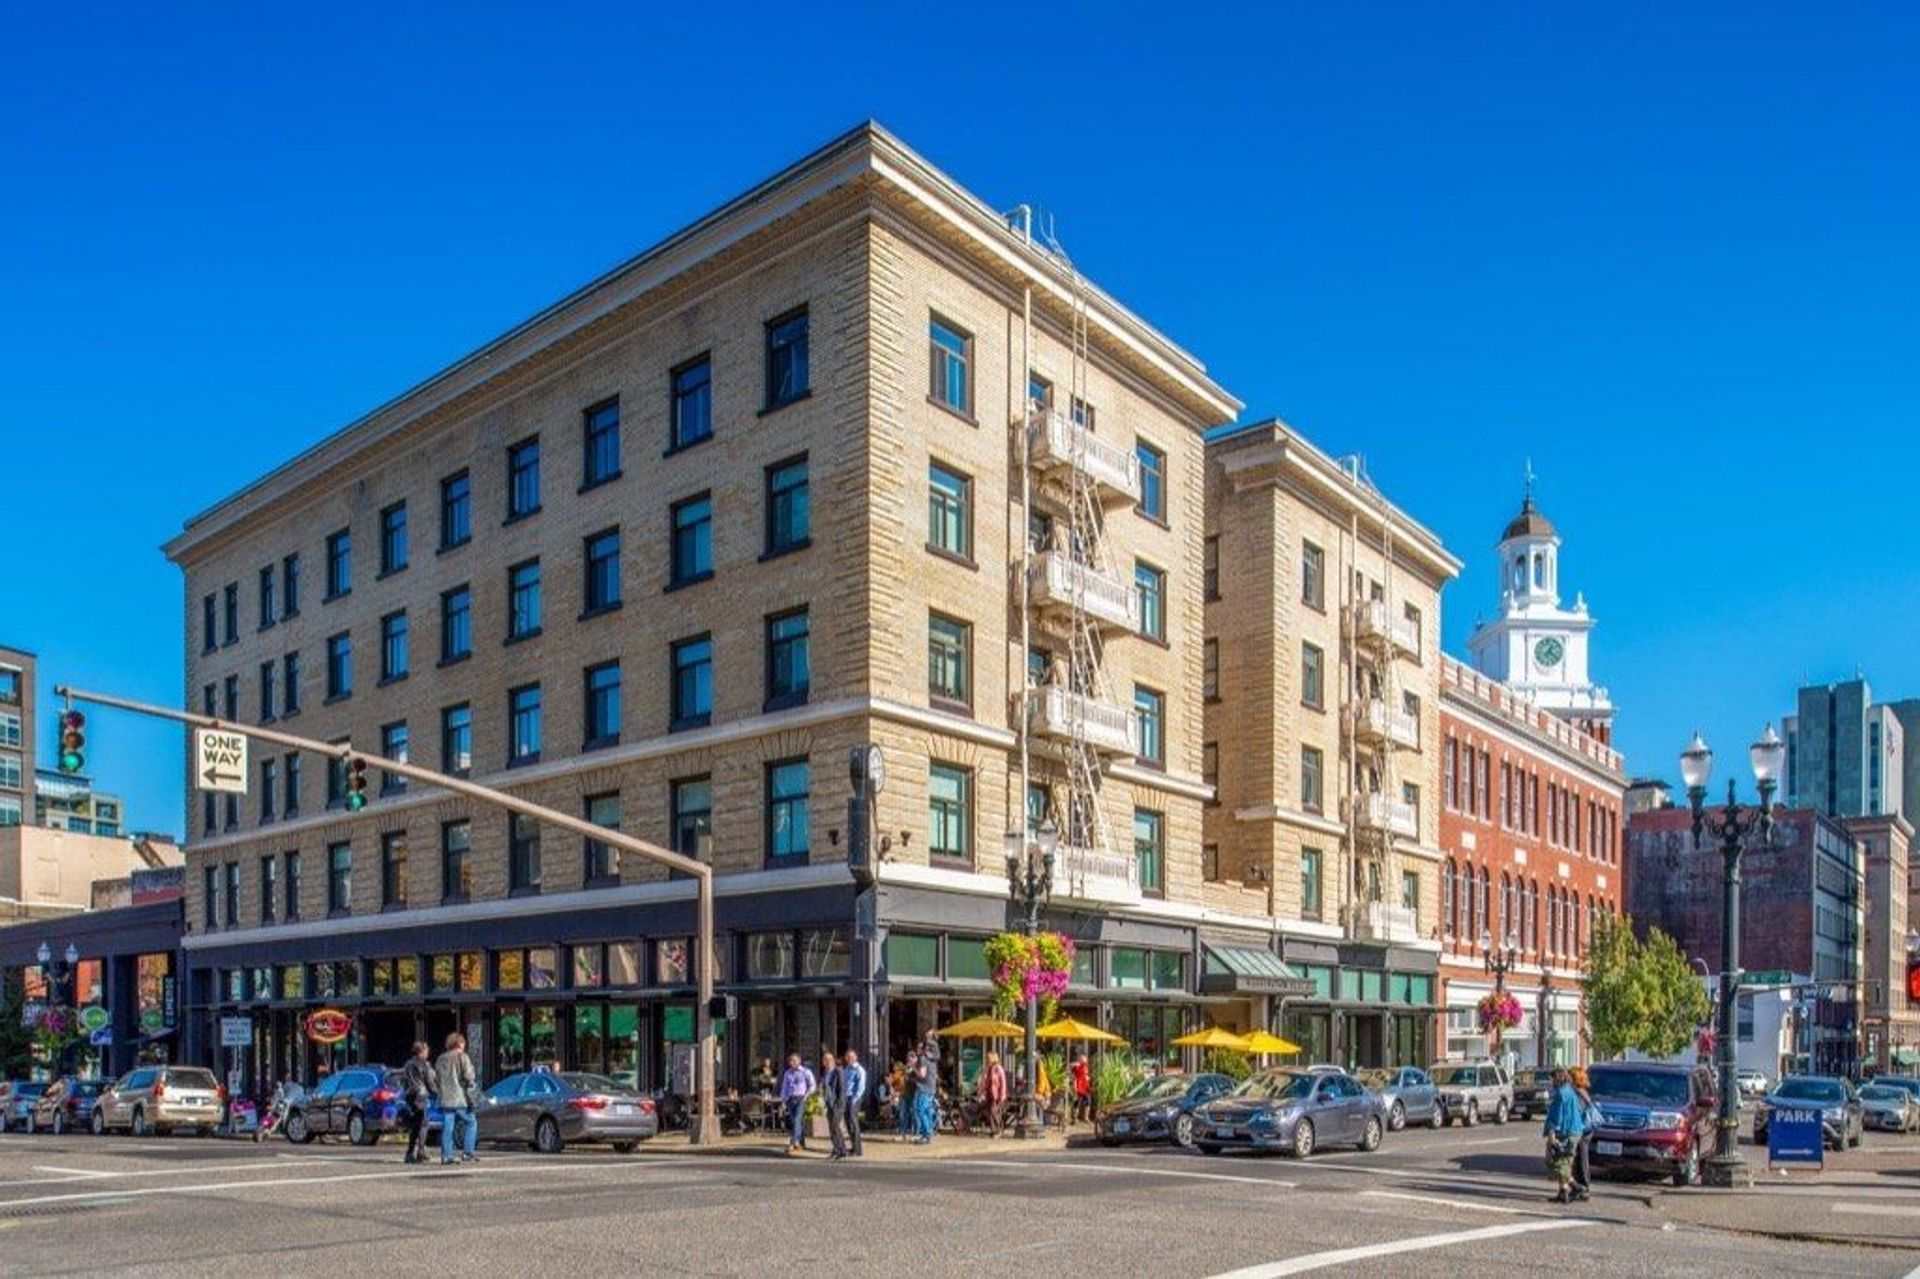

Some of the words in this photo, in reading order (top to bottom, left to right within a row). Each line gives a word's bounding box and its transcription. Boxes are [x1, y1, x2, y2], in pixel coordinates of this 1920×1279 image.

[204, 734, 242, 751] ONE
[204, 749, 242, 767] WAY
[1776, 1110, 1816, 1123] PARK
